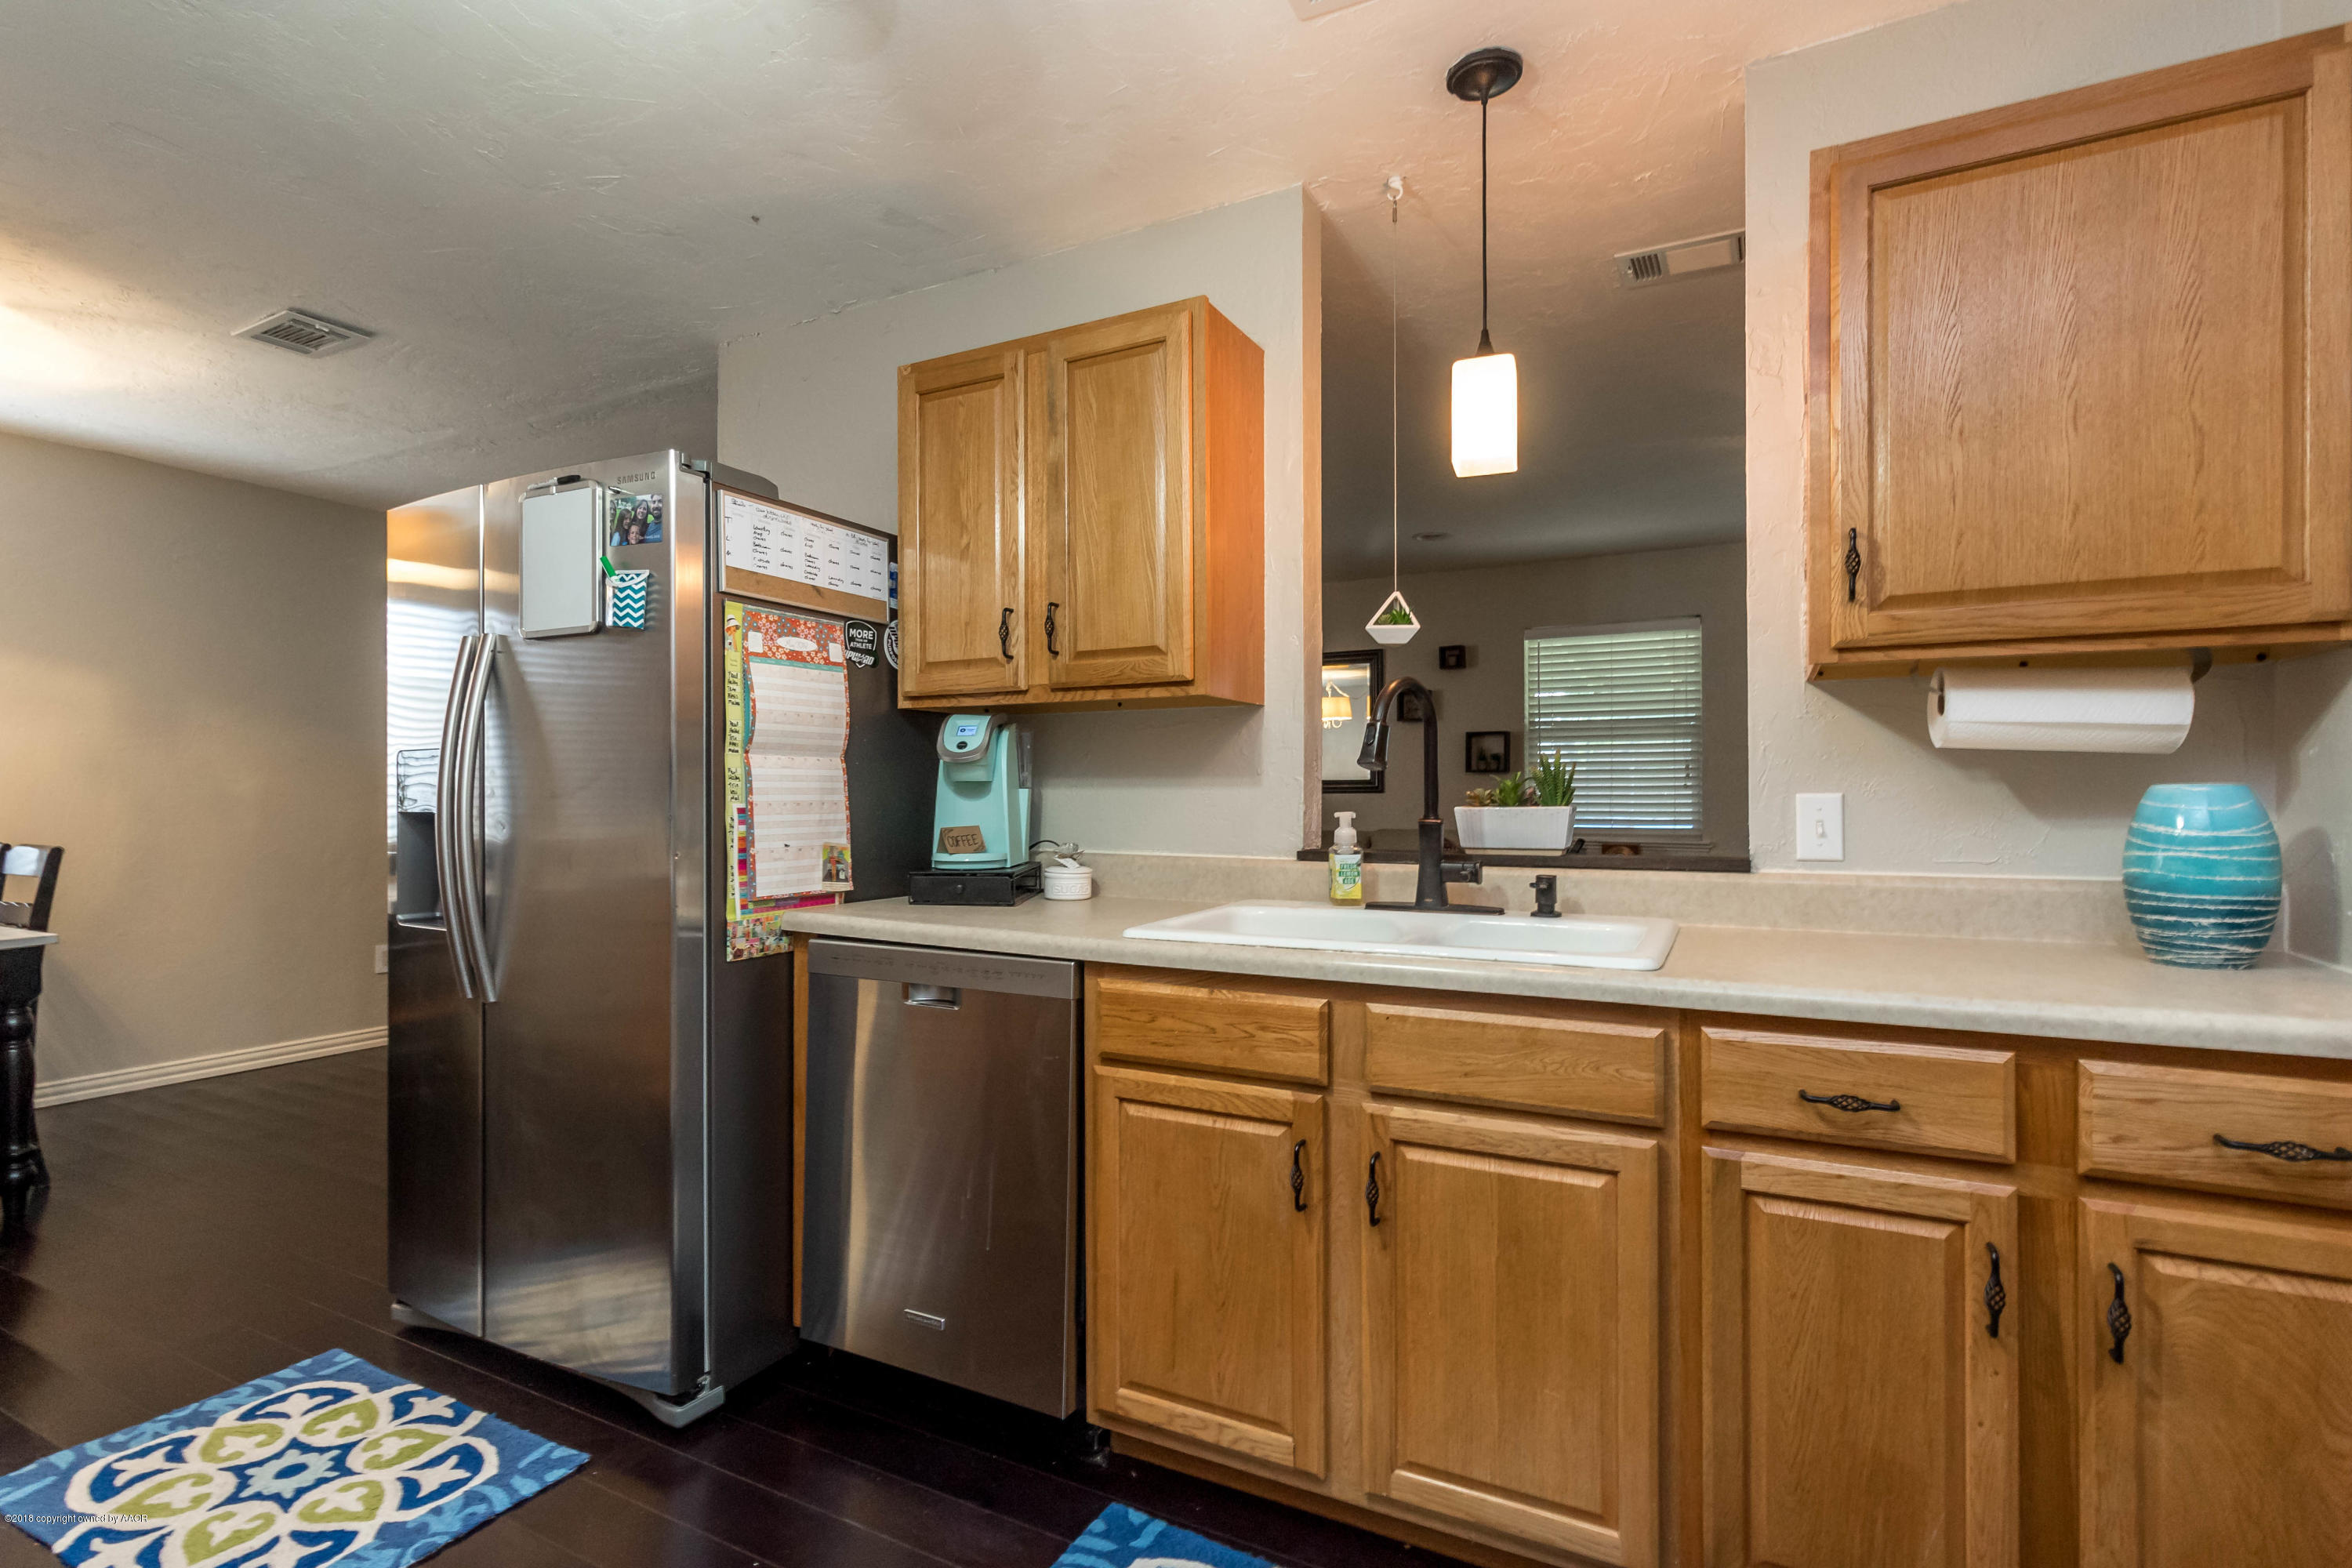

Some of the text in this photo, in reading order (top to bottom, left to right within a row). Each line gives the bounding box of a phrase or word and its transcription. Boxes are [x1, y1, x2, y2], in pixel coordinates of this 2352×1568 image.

[617, 471, 655, 485] SAMSUNG
[849, 629, 874, 640] MORE
[850, 641, 873, 650] ATHLETE
[947, 834, 978, 847] COFFEE
